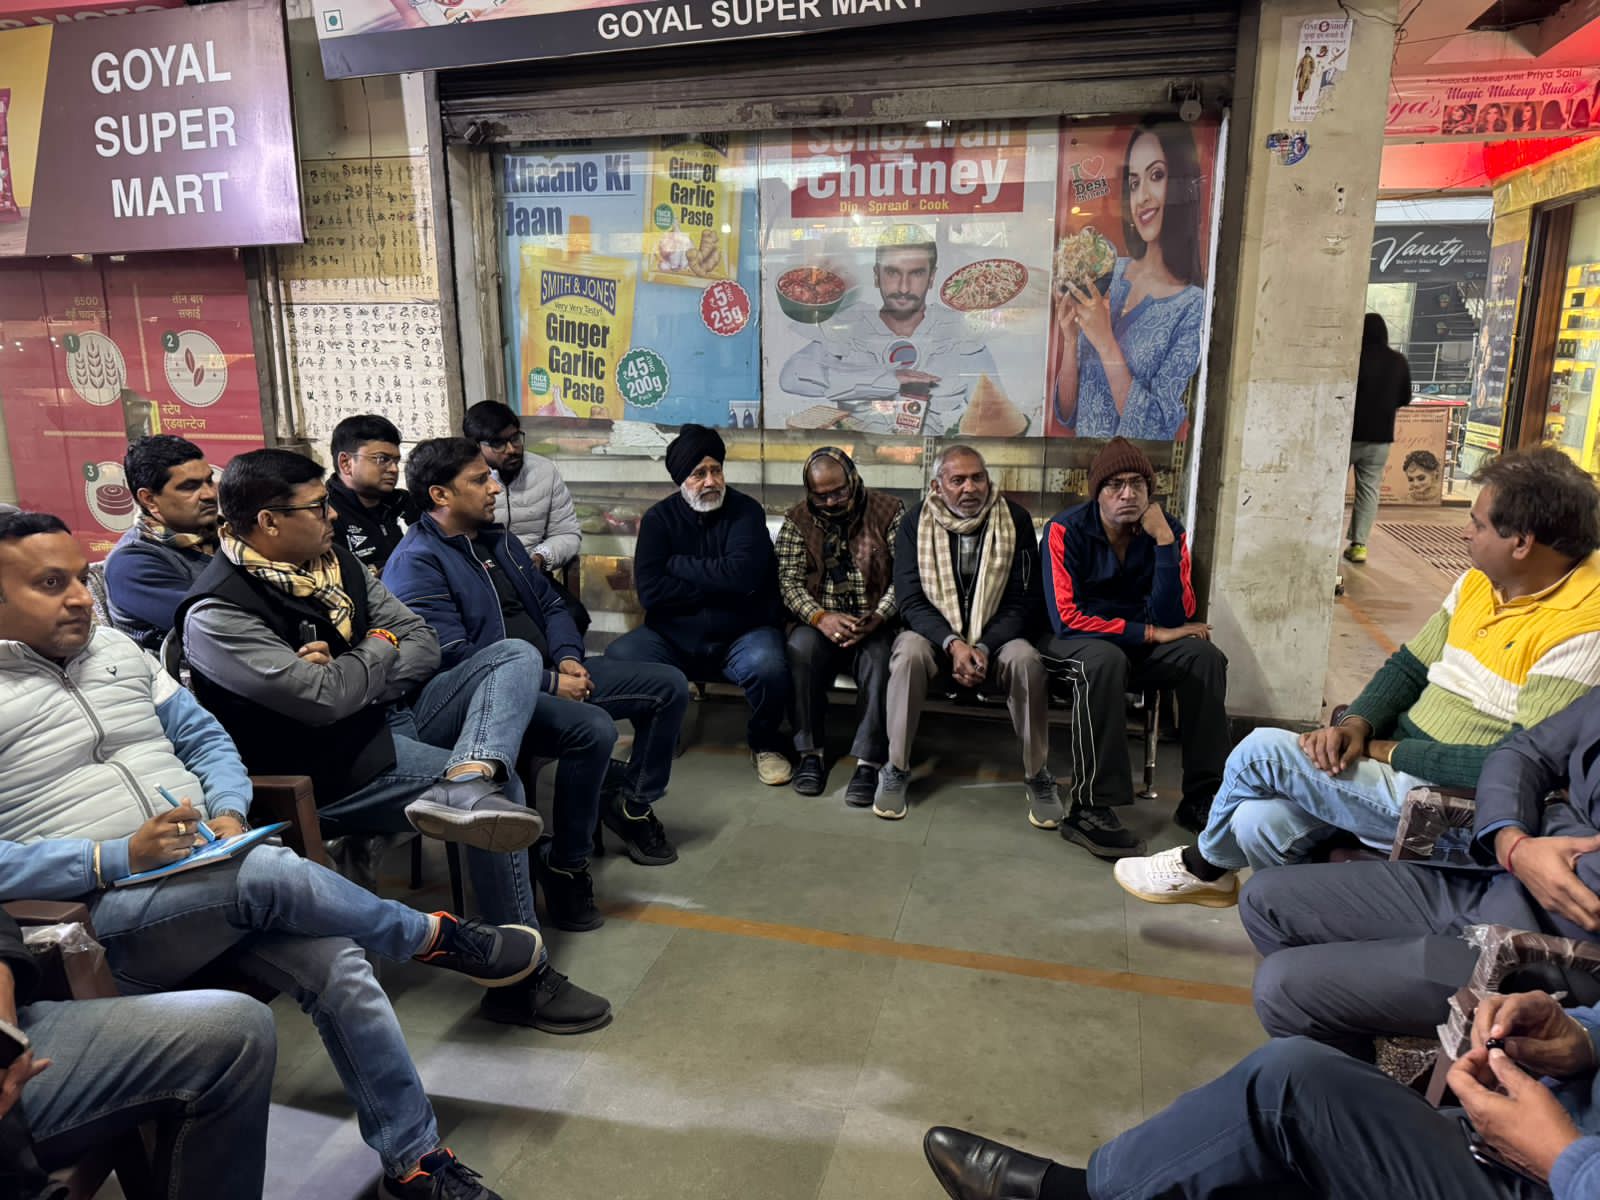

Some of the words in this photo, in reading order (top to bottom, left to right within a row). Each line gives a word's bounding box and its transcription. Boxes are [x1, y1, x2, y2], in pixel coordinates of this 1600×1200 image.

[597, 5, 703, 40] GOYAL
[711, 0, 822, 28] SUPER
[832, 0, 922, 15] MA
[91, 40, 232, 94] GOYAL
[1527, 70, 1554, 81] Priya
[1556, 68, 1582, 78] Saini
[1447, 86, 1483, 102] Magic
[1487, 84, 1536, 99] Makeup
[1539, 81, 1575, 96] Studio
[95, 106, 237, 157] SUPER
[503, 157, 598, 193] Khaane
[604, 154, 632, 192] Ki
[669, 157, 719, 184] Ginger
[806, 152, 1009, 204] Chutney
[1075, 176, 1107, 195] Desi
[111, 172, 229, 218] MART
[670, 182, 715, 208] Garlic
[840, 201, 858, 213] Dip
[868, 200, 909, 213] Spread
[919, 199, 949, 211] Cook
[505, 201, 563, 237] Jaan
[680, 207, 714, 227] Paste
[1372, 232, 1464, 272] Vanity
[542, 272, 571, 301] SMITH
[573, 277, 581, 294] &
[582, 279, 615, 311] JONES
[546, 312, 610, 349] Ginger
[711, 305, 744, 329] 25g
[548, 345, 606, 380] Garlic
[563, 376, 605, 404] Paste
[626, 375, 663, 398] 200g
